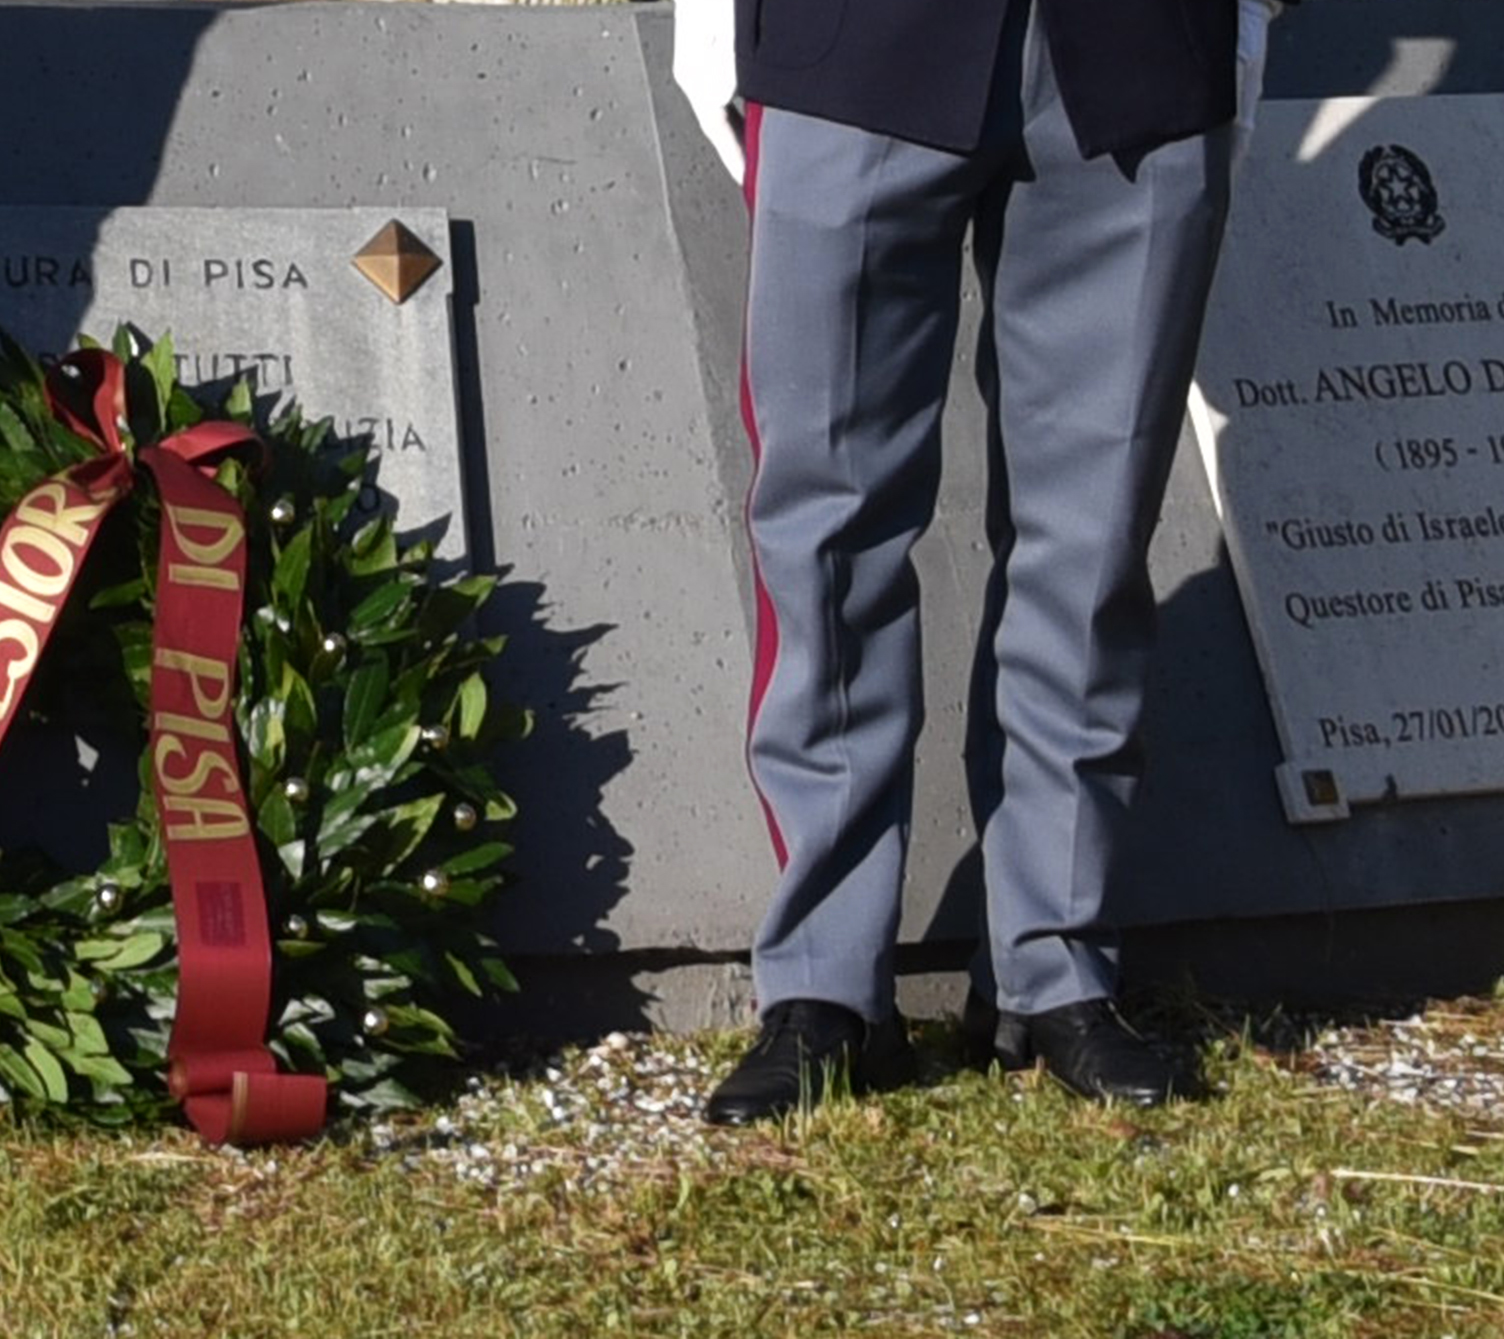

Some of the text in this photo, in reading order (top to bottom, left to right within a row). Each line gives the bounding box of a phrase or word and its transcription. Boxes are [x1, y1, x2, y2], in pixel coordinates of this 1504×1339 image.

[129, 258, 171, 289] DI
[204, 259, 309, 290] PISA
[1326, 300, 1358, 329] In
[1369, 294, 1491, 326] Memoria
[1234, 377, 1309, 409] Dott.
[1314, 360, 1472, 403] ANGELO
[167, 503, 247, 591] DI
[1267, 515, 1375, 552] "Giusto
[1381, 510, 1411, 543] di
[1284, 587, 1413, 627] Questore
[1421, 580, 1448, 611] di
[154, 647, 250, 841] PISA
[1318, 715, 1391, 751] Pisa,
